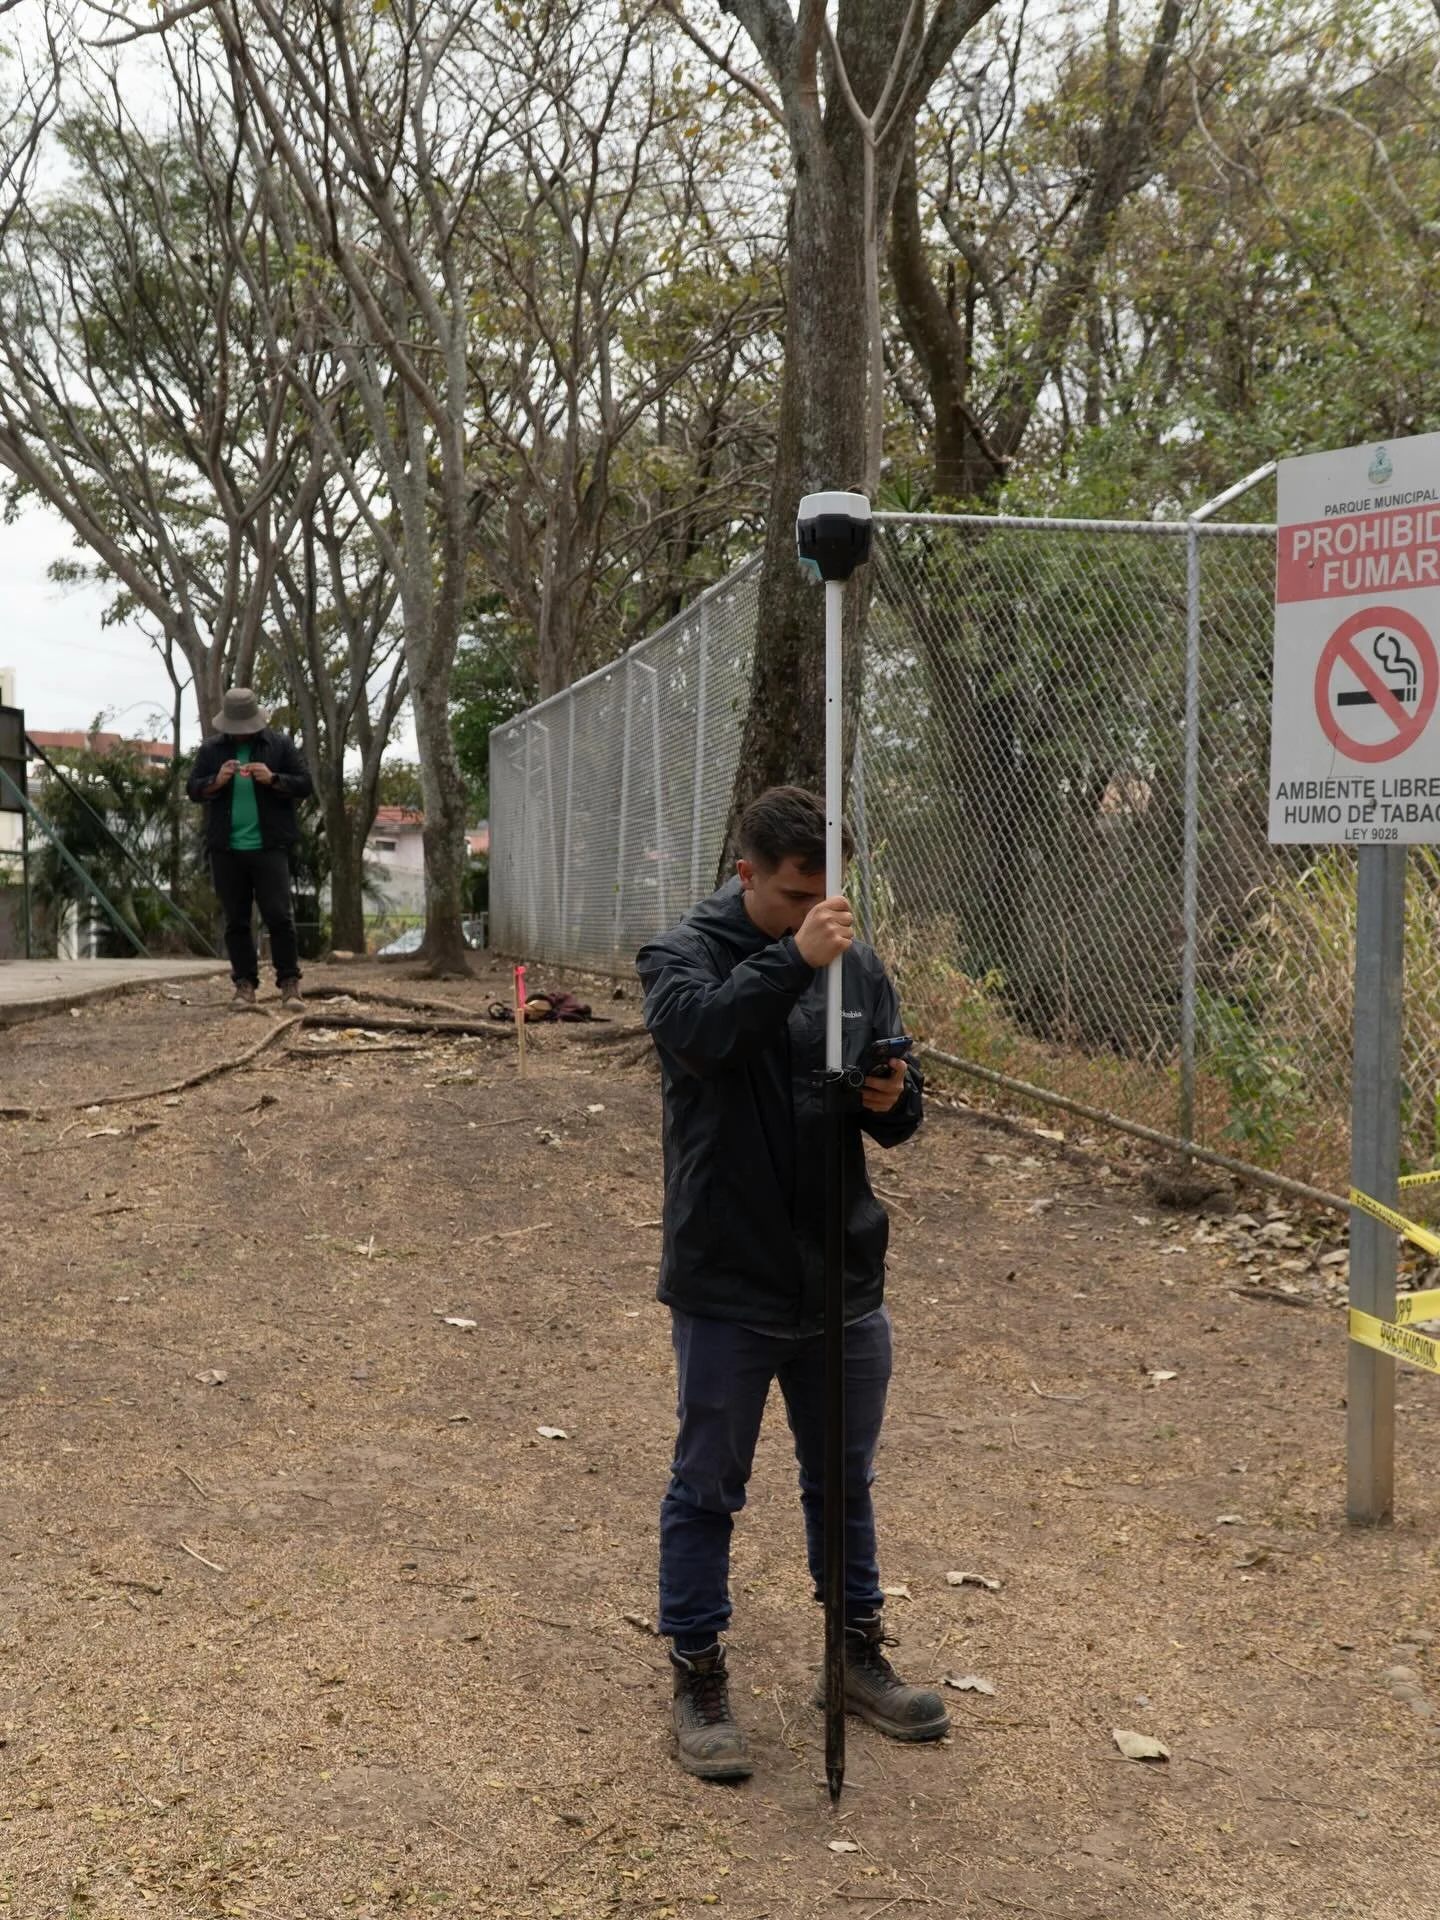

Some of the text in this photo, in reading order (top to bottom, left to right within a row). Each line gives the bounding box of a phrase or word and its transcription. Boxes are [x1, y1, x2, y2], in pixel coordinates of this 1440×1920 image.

[1324, 488, 1439, 517] PARQUE MUNICIPAL
[1292, 510, 1440, 561] PROHIBID
[1323, 548, 1440, 593] FUMAR
[1276, 778, 1440, 800] AMBIENTE LIBRE
[1284, 805, 1341, 824] HUMO
[1347, 805, 1375, 823] DE
[1344, 828, 1398, 840] LEY 9028
